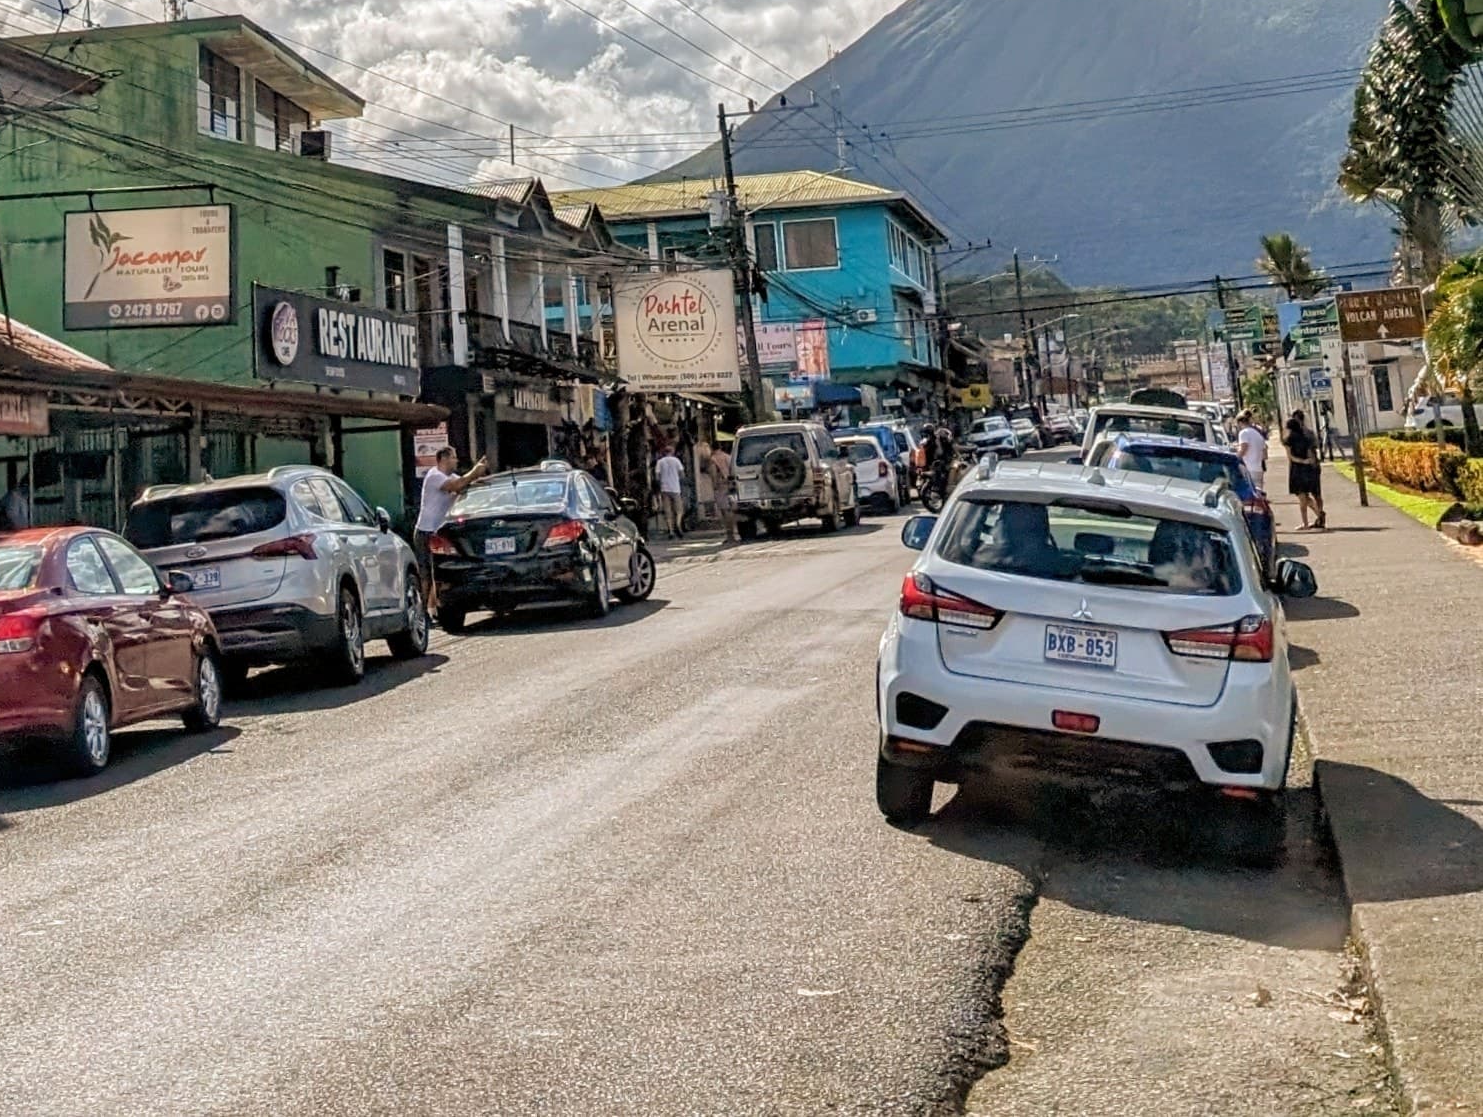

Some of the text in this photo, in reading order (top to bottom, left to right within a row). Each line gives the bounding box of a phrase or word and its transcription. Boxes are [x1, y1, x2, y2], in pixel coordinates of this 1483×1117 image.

[103, 246, 207, 274] Jacamar
[124, 303, 152, 317] 2479
[645, 289, 707, 317] Poshtel
[648, 316, 705, 332] Arenal
[318, 307, 417, 368] RESTAURANTE
[1048, 633, 1114, 658] BXB-853
